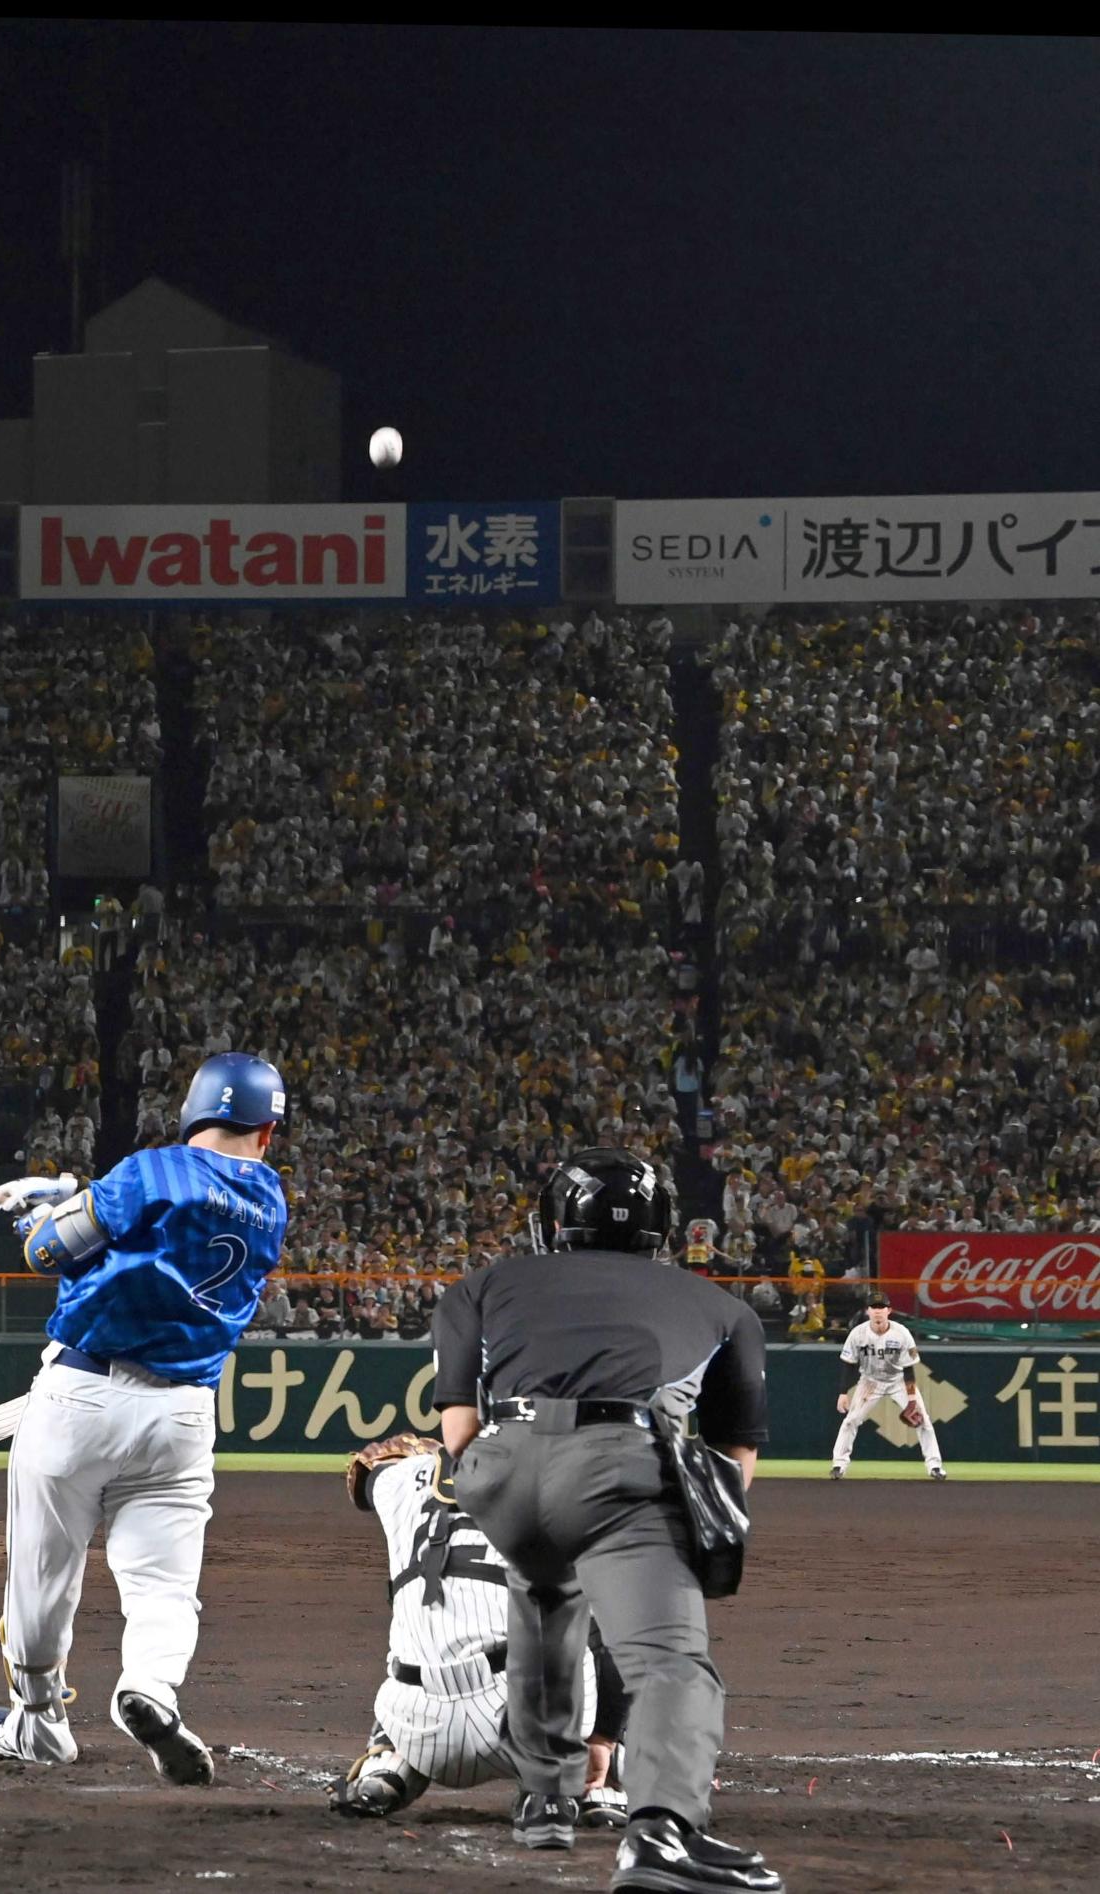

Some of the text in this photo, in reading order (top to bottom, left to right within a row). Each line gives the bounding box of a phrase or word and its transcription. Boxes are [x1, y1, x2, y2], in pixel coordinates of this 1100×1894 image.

[40, 515, 386, 587] Iwatani
[426, 513, 539, 568] 水素
[803, 513, 1100, 579] 渡辺パイ
[425, 573, 539, 595] エネルギー
[667, 566, 725, 579] SYSTEM
[221, 1086, 233, 1103] 2
[204, 1184, 277, 1233] MAKI
[192, 1233, 248, 1316] 2
[994, 1353, 1100, 1448] 住
